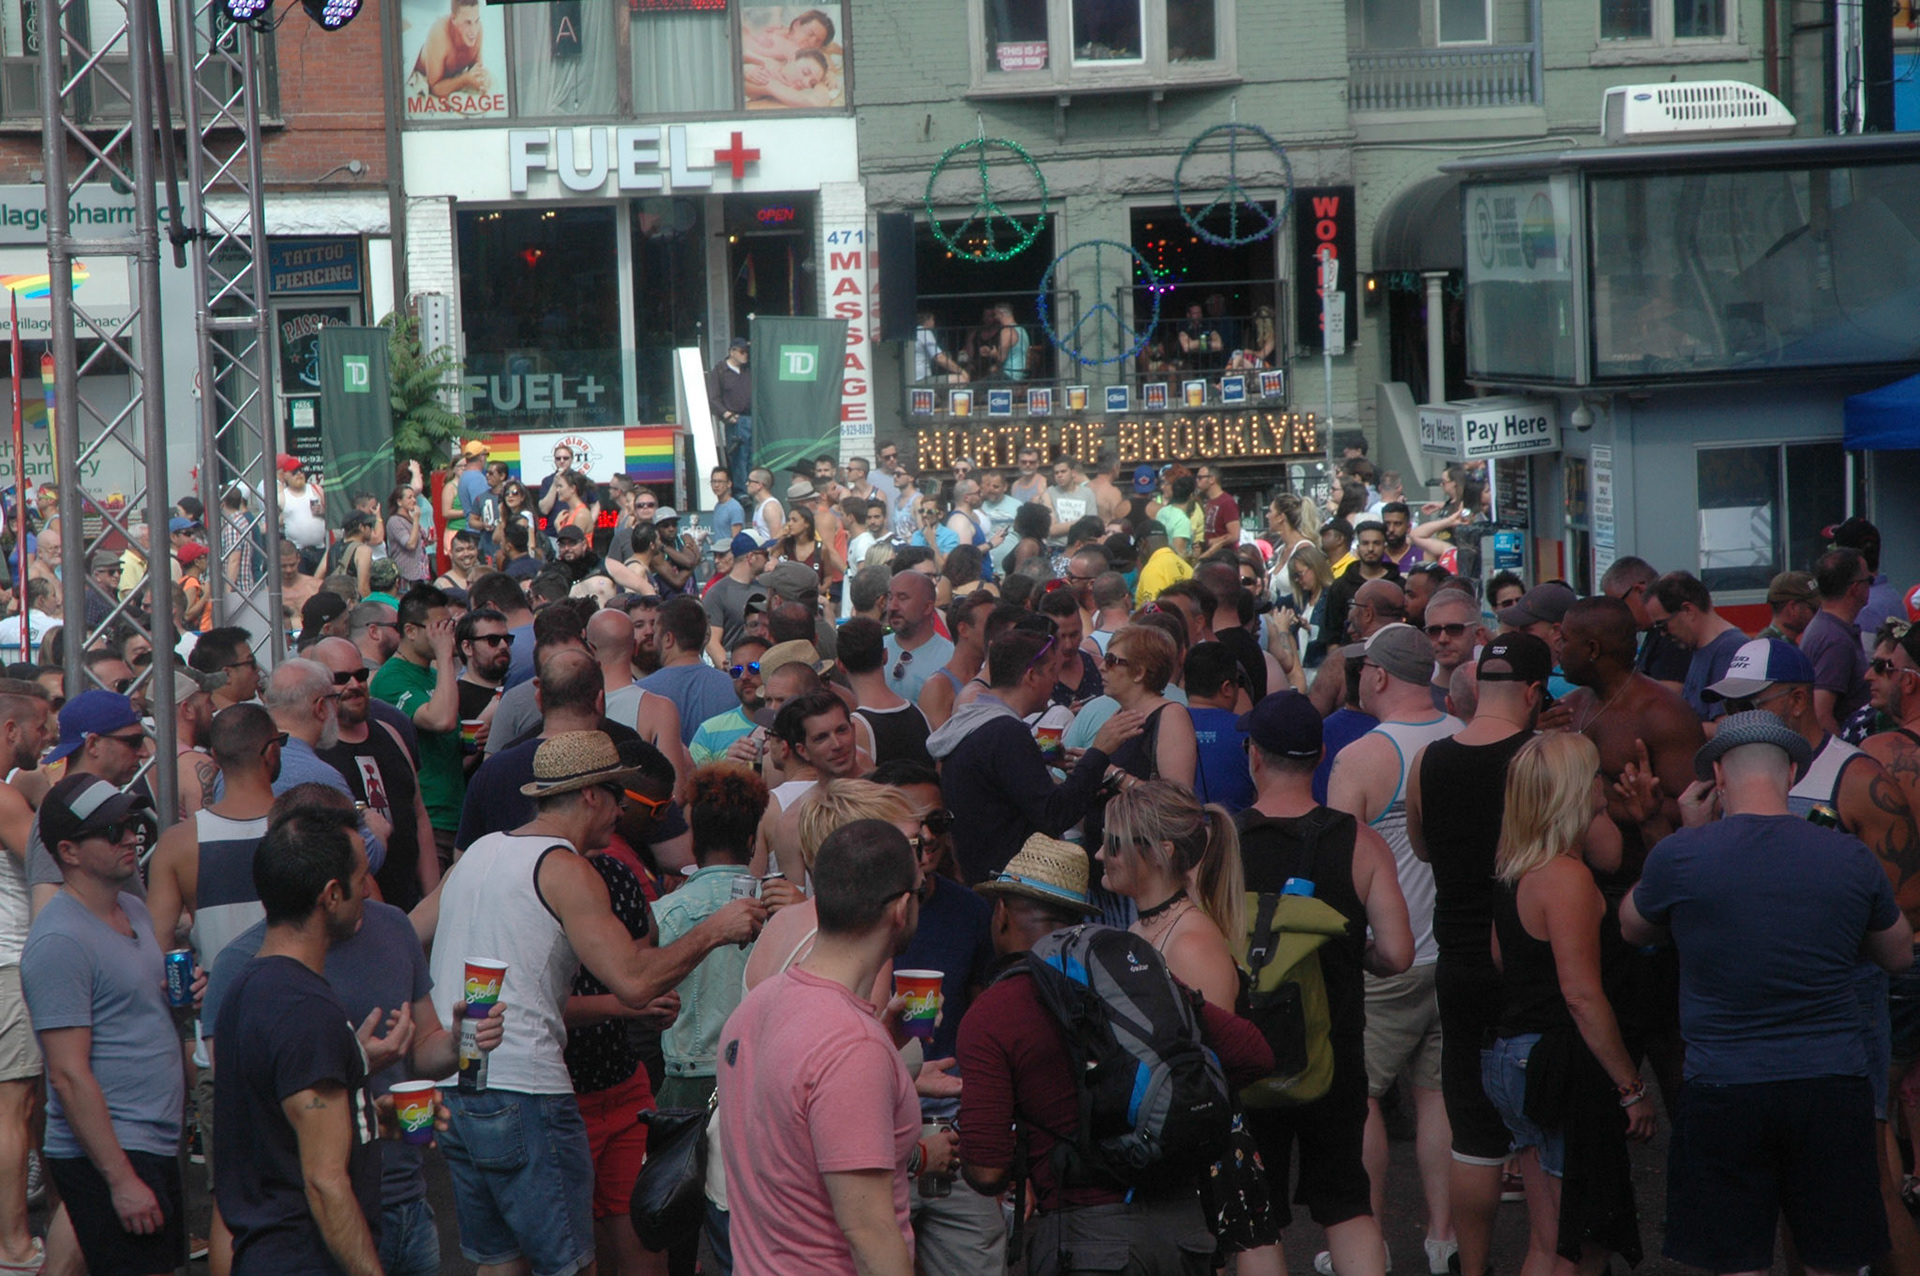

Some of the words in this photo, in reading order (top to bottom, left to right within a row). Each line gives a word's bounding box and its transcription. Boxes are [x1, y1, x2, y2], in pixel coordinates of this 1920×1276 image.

[556, 16, 577, 44] A
[407, 94, 506, 114] MASSAGE
[757, 207, 796, 221] OPEN
[827, 230, 864, 244] 471
[282, 244, 345, 267] TATTOO
[275, 265, 353, 291] PIERCING
[346, 362, 368, 386] TD
[784, 350, 813, 374] TD
[917, 423, 1051, 471] NORTH
[1060, 420, 1105, 464] OF
[1118, 411, 1318, 462] BROOKLYN
[1421, 417, 1435, 444] Pay
[1436, 419, 1455, 442] Here
[1466, 420, 1499, 444] Pay
[1504, 414, 1548, 437] Here
